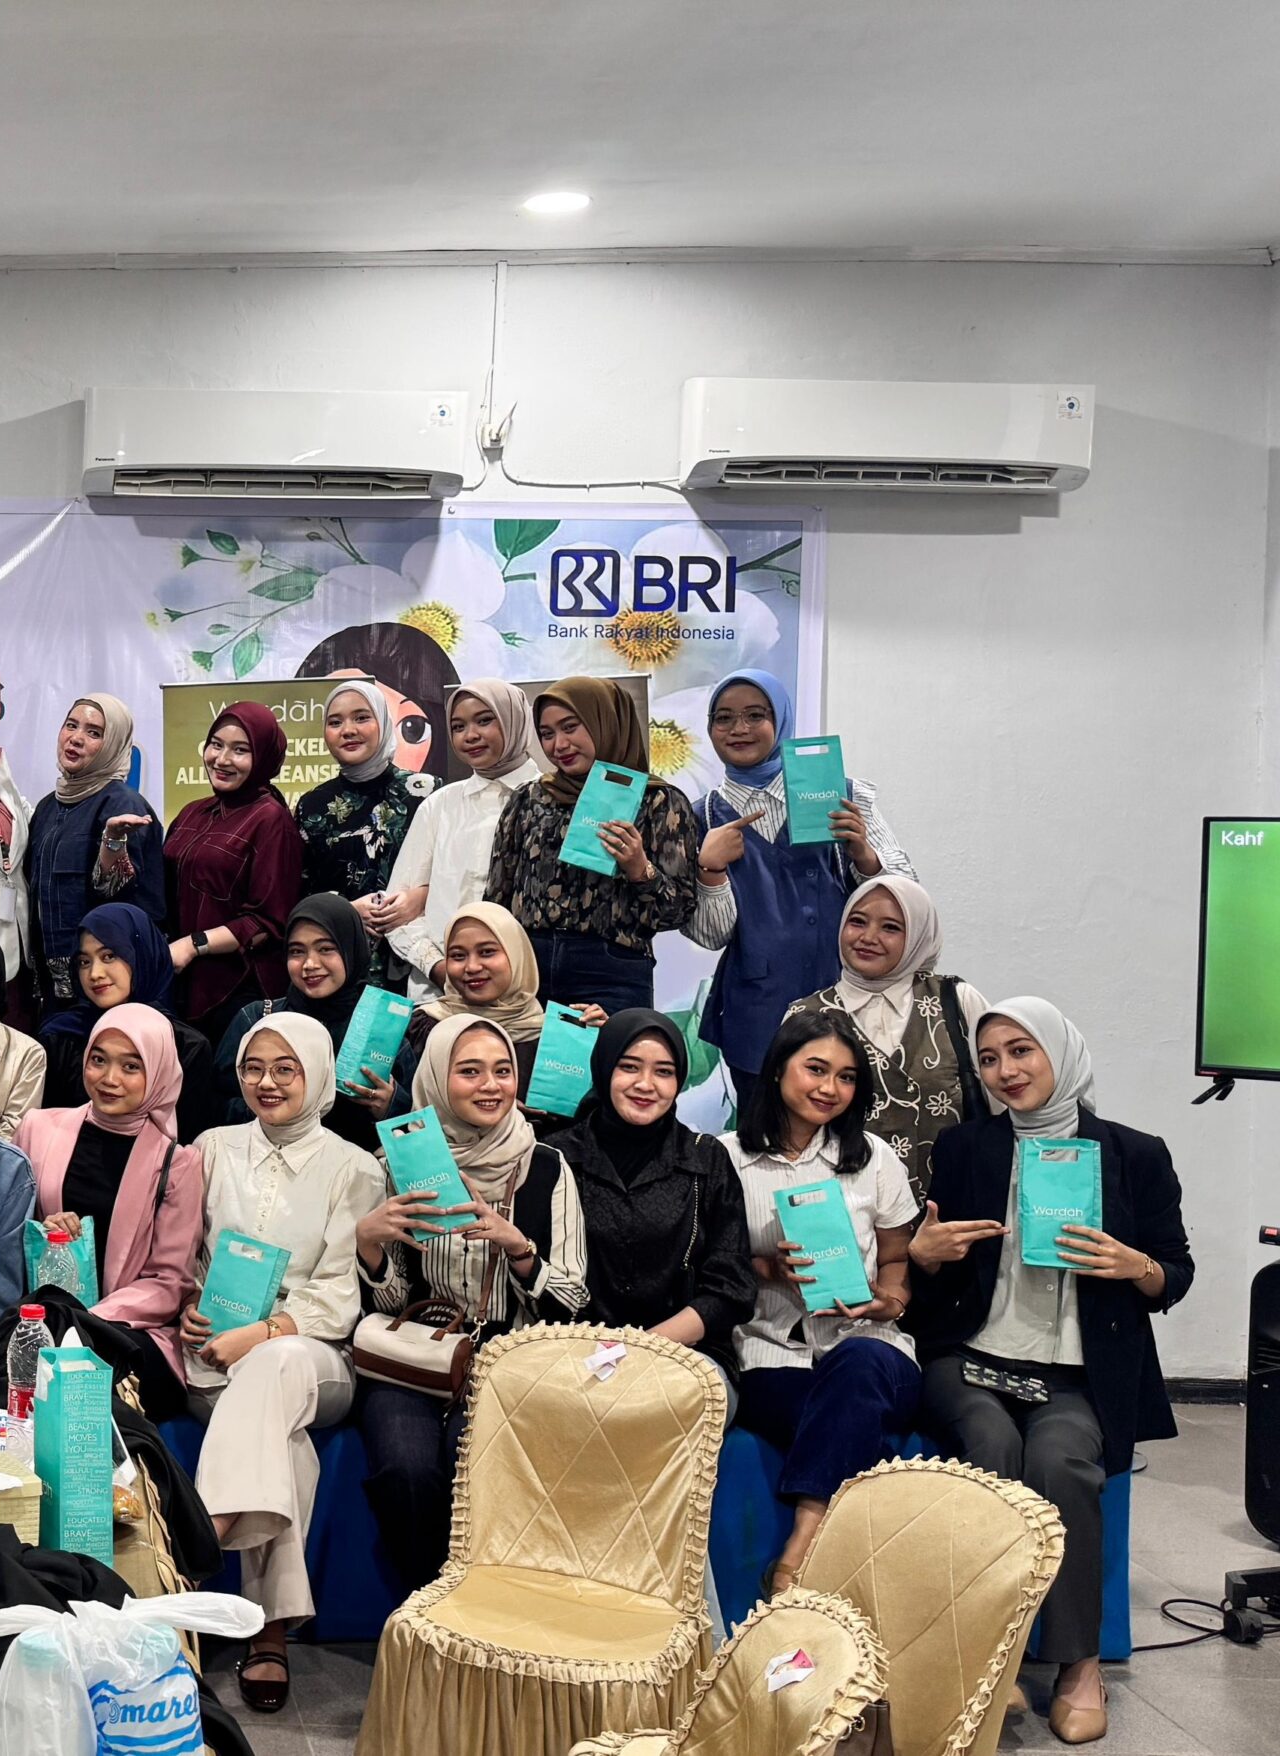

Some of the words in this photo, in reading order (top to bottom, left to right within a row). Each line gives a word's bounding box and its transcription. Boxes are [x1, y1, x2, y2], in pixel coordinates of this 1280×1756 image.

[632, 555, 737, 613] BRI
[548, 624, 588, 638] Bank
[594, 624, 650, 641] Rakyat
[656, 624, 735, 641] Indonesia
[270, 764, 342, 784] LEANSE
[582, 815, 603, 828] War
[1221, 831, 1265, 846] Kahf
[68, 1423, 101, 1431] BEAUTY
[68, 1433, 97, 1442] MOVES
[69, 1445, 87, 1453] YOU
[64, 1529, 92, 1537] BRAVE
